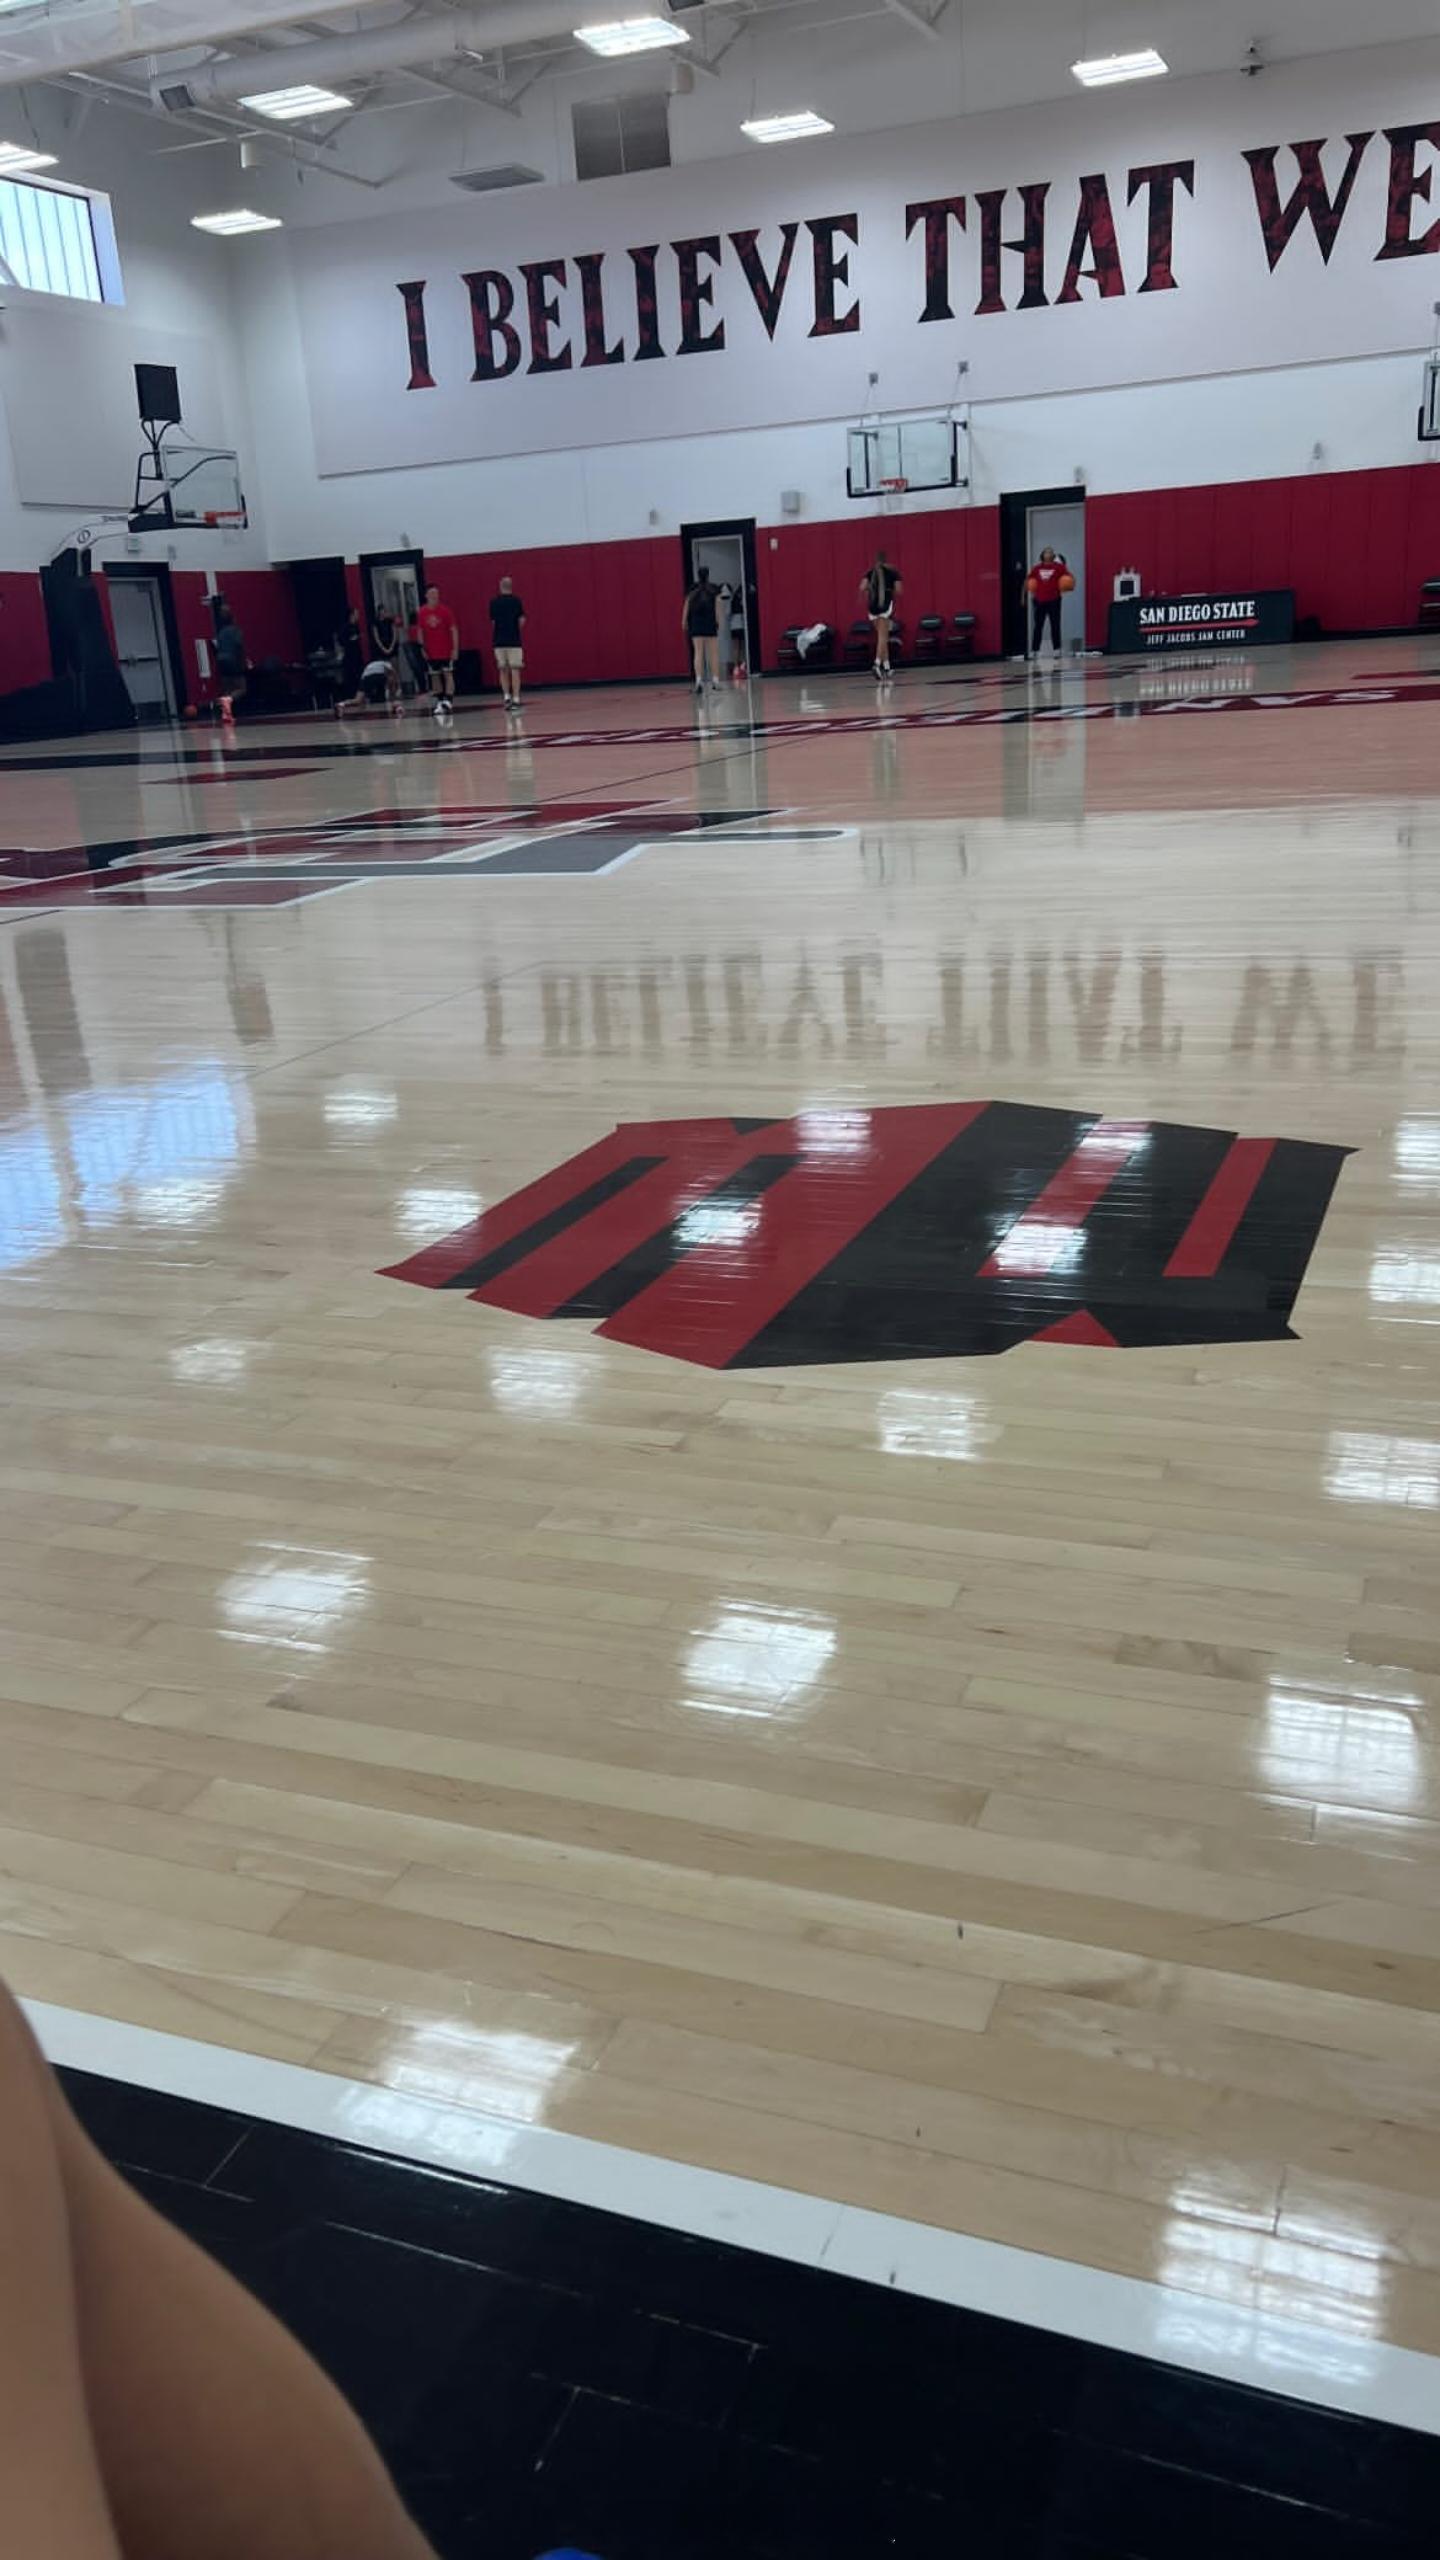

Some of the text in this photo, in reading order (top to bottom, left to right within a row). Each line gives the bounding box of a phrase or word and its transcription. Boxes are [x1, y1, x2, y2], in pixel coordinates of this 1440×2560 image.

[396, 120, 1440, 391] I BELIEVE THAT WE
[1139, 600, 1255, 624] SAN DIEGO STATE
[1147, 629, 1245, 645] JEFF JACOBS JAM CENTER
